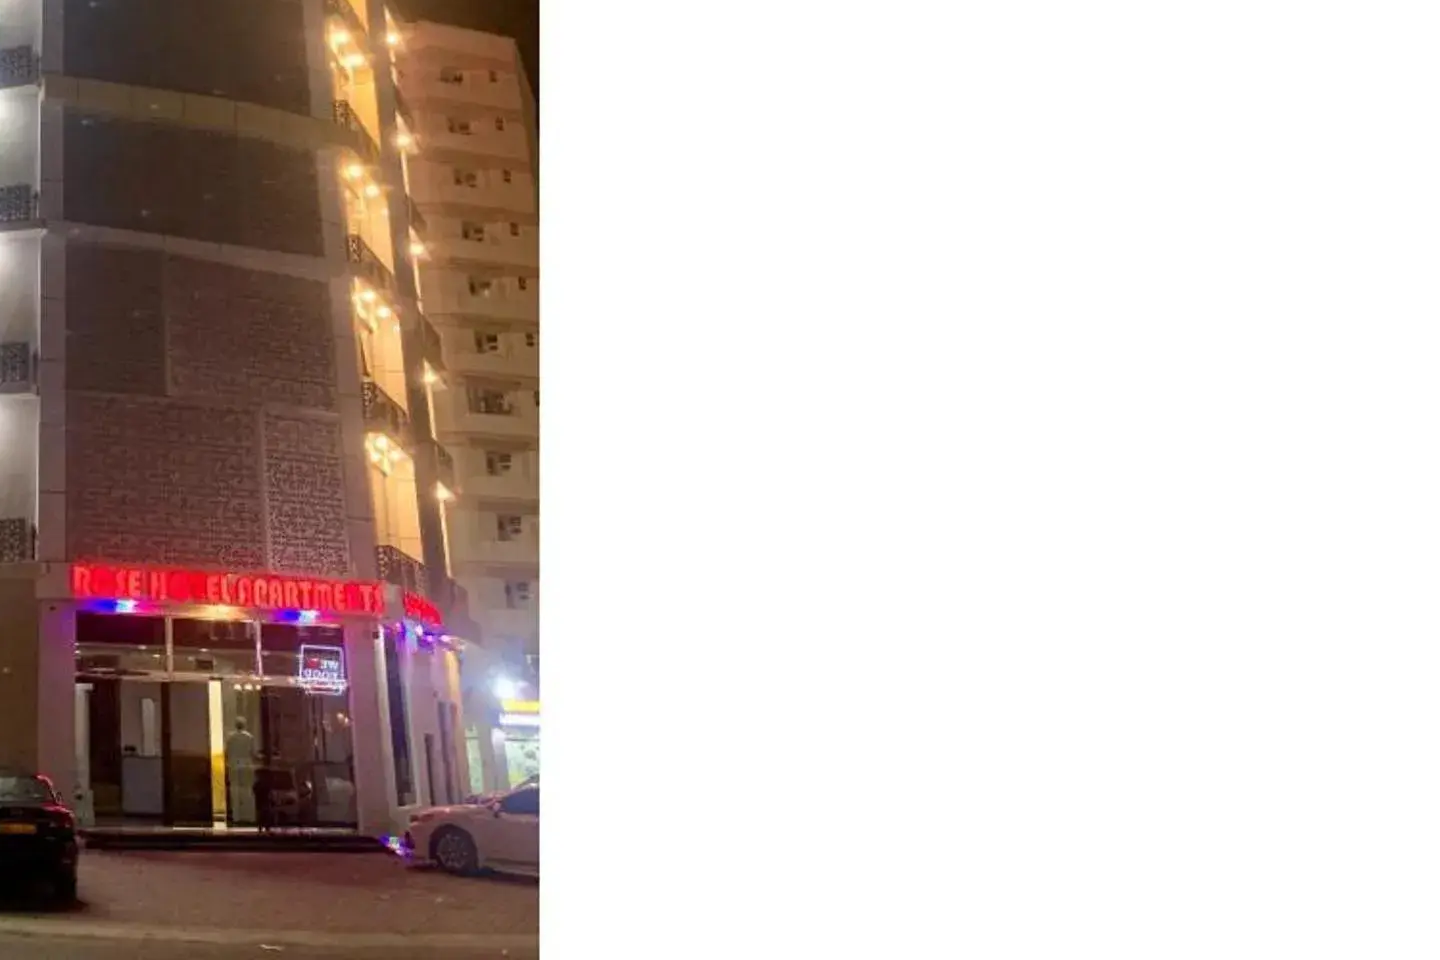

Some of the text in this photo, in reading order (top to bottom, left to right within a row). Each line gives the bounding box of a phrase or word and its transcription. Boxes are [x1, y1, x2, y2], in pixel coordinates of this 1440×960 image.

[74, 565, 141, 599] RSE
[150, 570, 233, 603] HEL
[236, 576, 384, 615] APARTMETS
